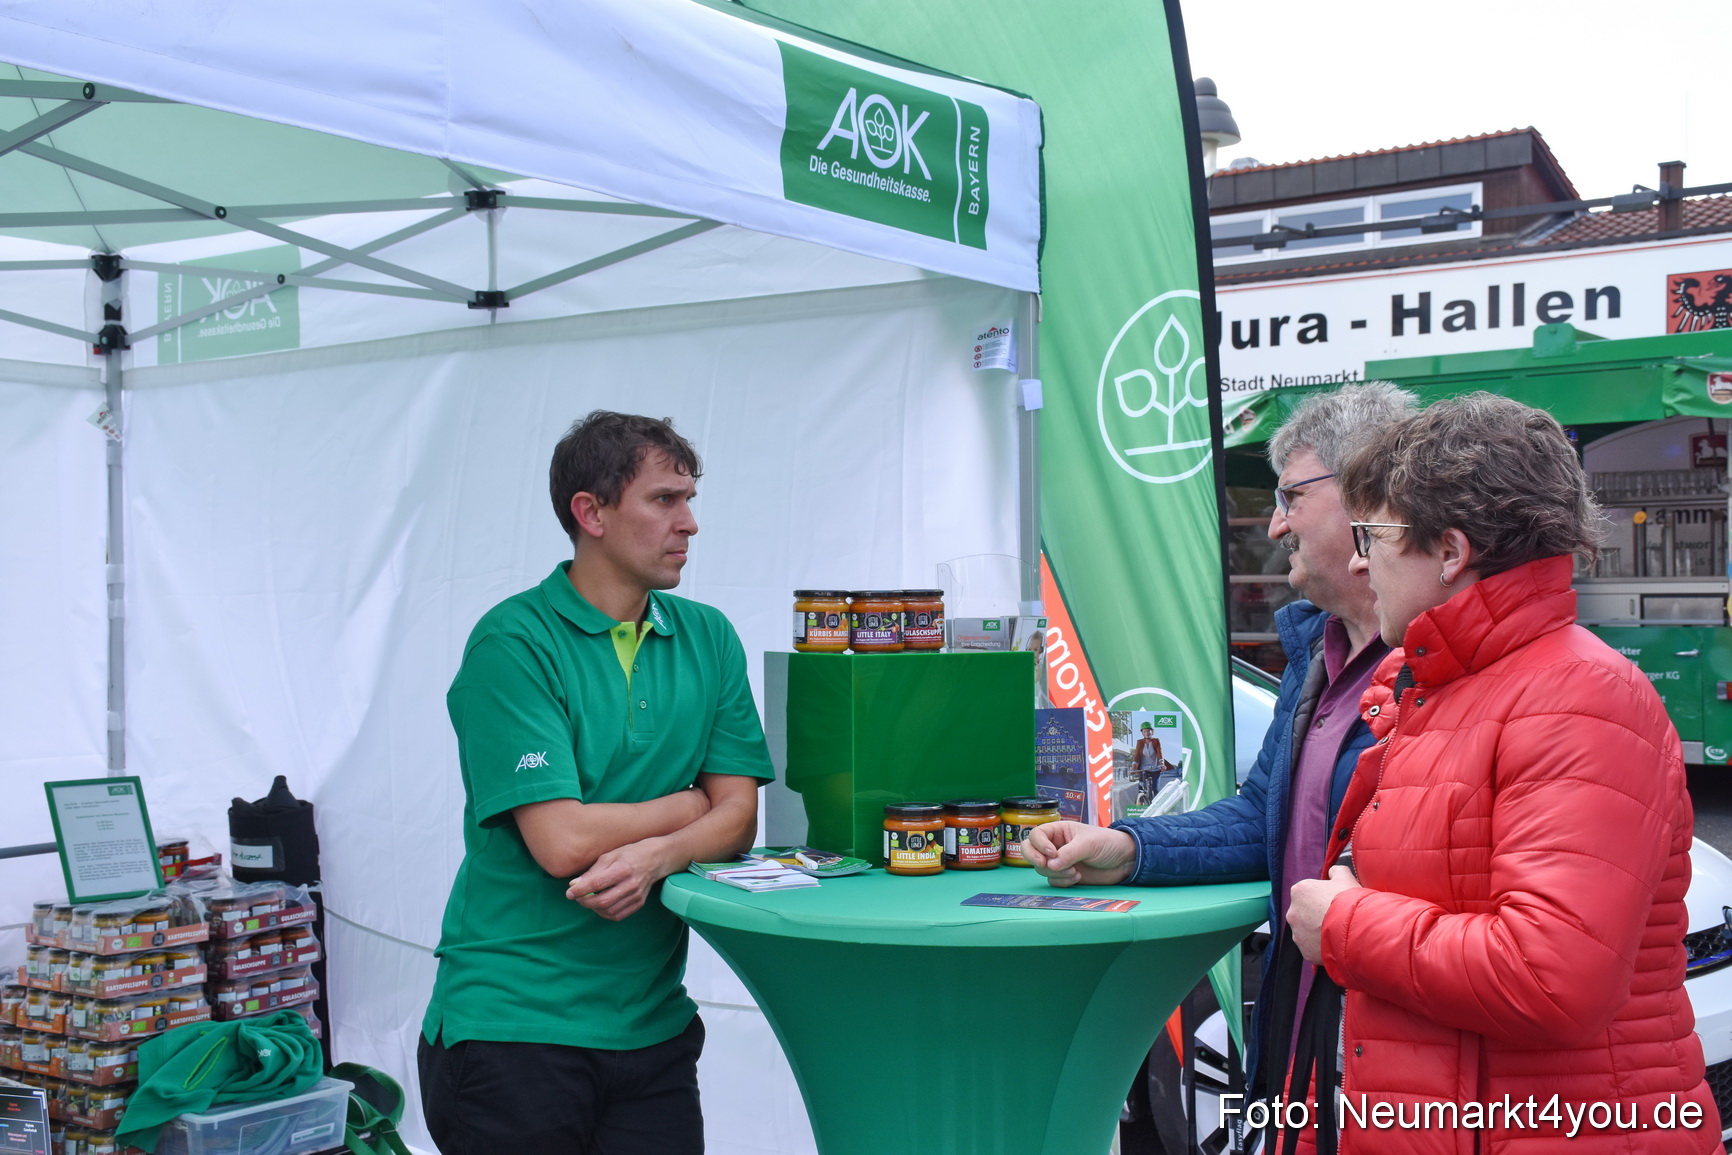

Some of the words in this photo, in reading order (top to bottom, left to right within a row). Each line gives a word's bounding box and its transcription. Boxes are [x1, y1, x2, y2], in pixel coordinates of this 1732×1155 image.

[816, 87, 933, 181] AOK
[968, 126, 981, 215] BAYERN
[809, 154, 828, 175] Die
[831, 162, 931, 203] Gesundheitskasse.
[1391, 282, 1622, 337] Hallen
[977, 327, 1010, 340] atento
[1220, 375, 1265, 393] Stadt
[1269, 369, 1358, 389] Neumarkt
[810, 629, 832, 637] KÜRBIS
[1665, 671, 1680, 680] KG
[1157, 717, 1174, 725] AOK
[515, 751, 549, 772] AOK
[896, 852, 915, 860] LITTLE
[917, 852, 936, 860] INDIA
[281, 910, 315, 922] GULASCHSUPPE
[168, 929, 208, 941] KARTOFFELSUPPE
[233, 960, 266, 971] GULASCHSUPPE
[105, 980, 148, 992] KARTOFFELSUPPE
[282, 989, 317, 1002] GULASCHSUPPE
[170, 1013, 210, 1025] KARTOFFELSUPPE
